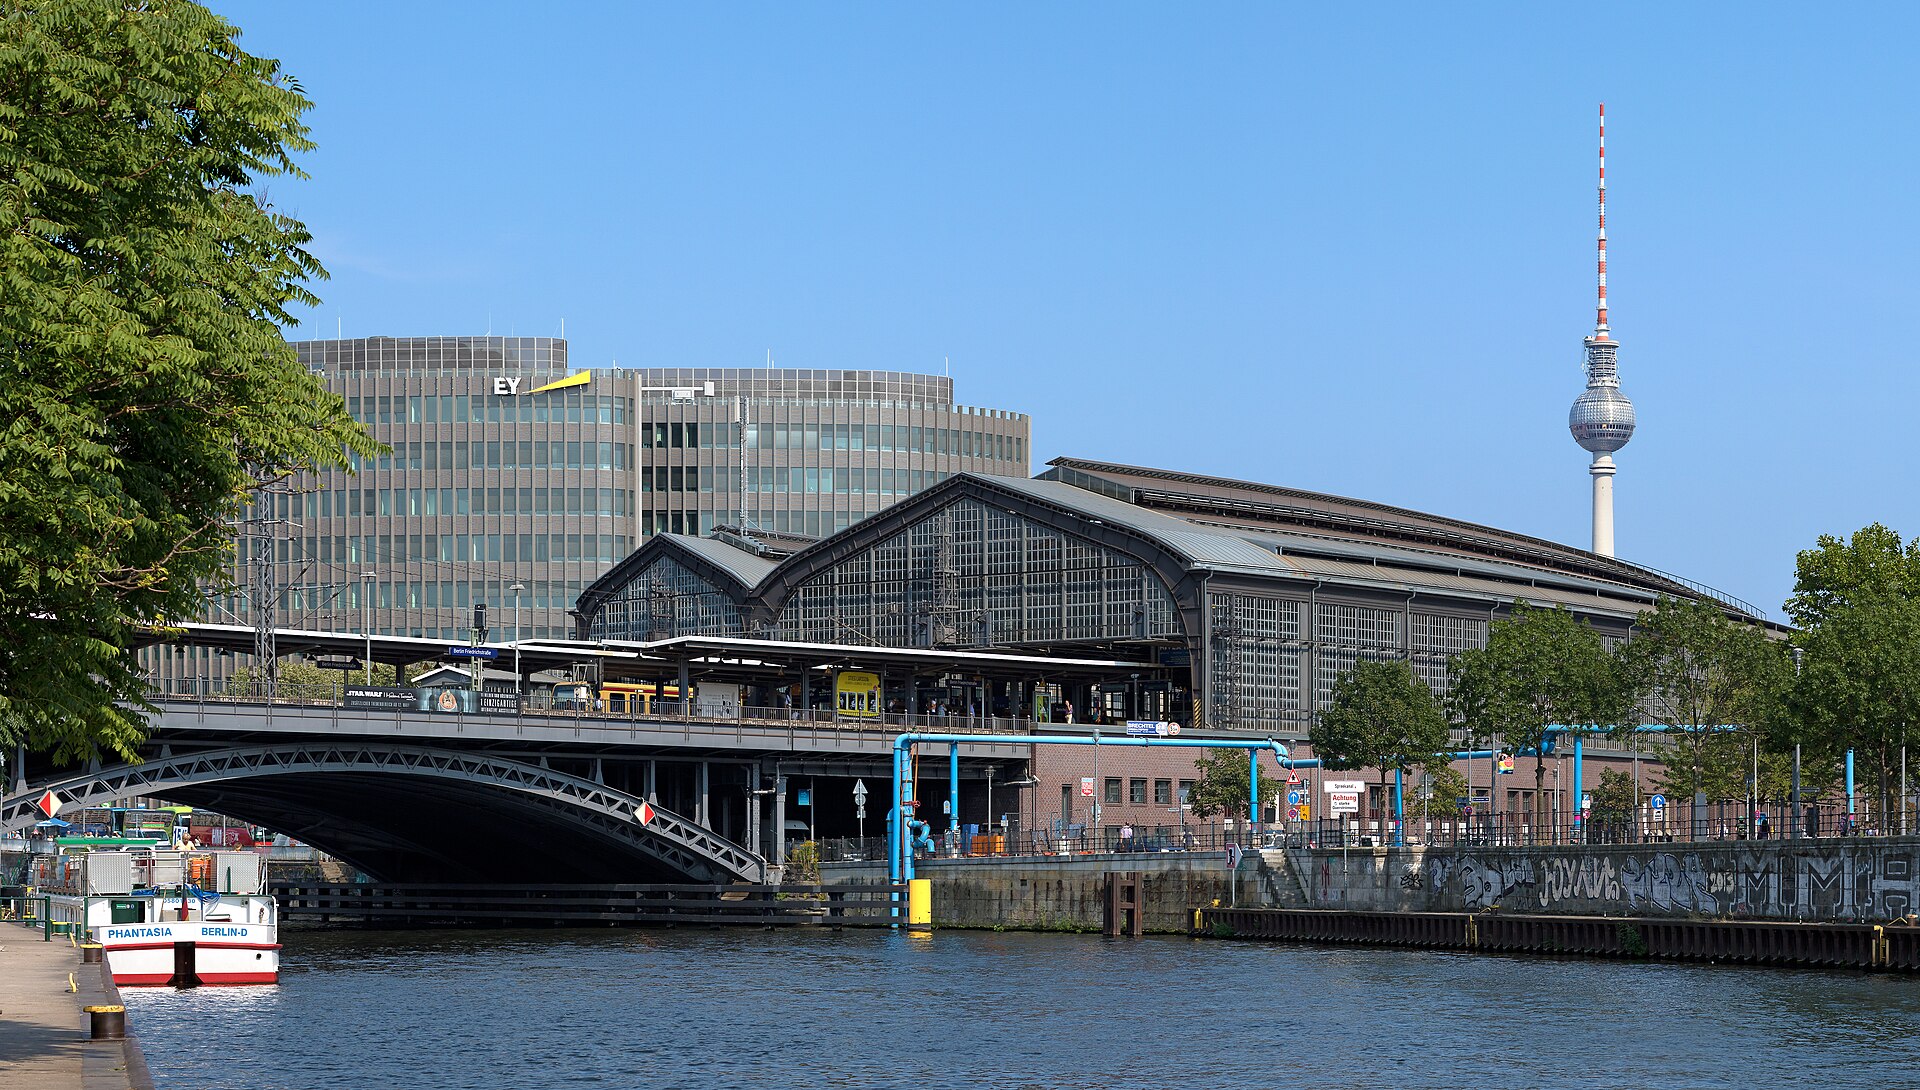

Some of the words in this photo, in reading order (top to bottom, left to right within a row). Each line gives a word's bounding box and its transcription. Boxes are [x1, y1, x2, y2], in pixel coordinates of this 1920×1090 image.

[494, 377, 521, 394] EY
[108, 927, 172, 939] PHANTASIA
[201, 927, 248, 937] BERLIN-D
